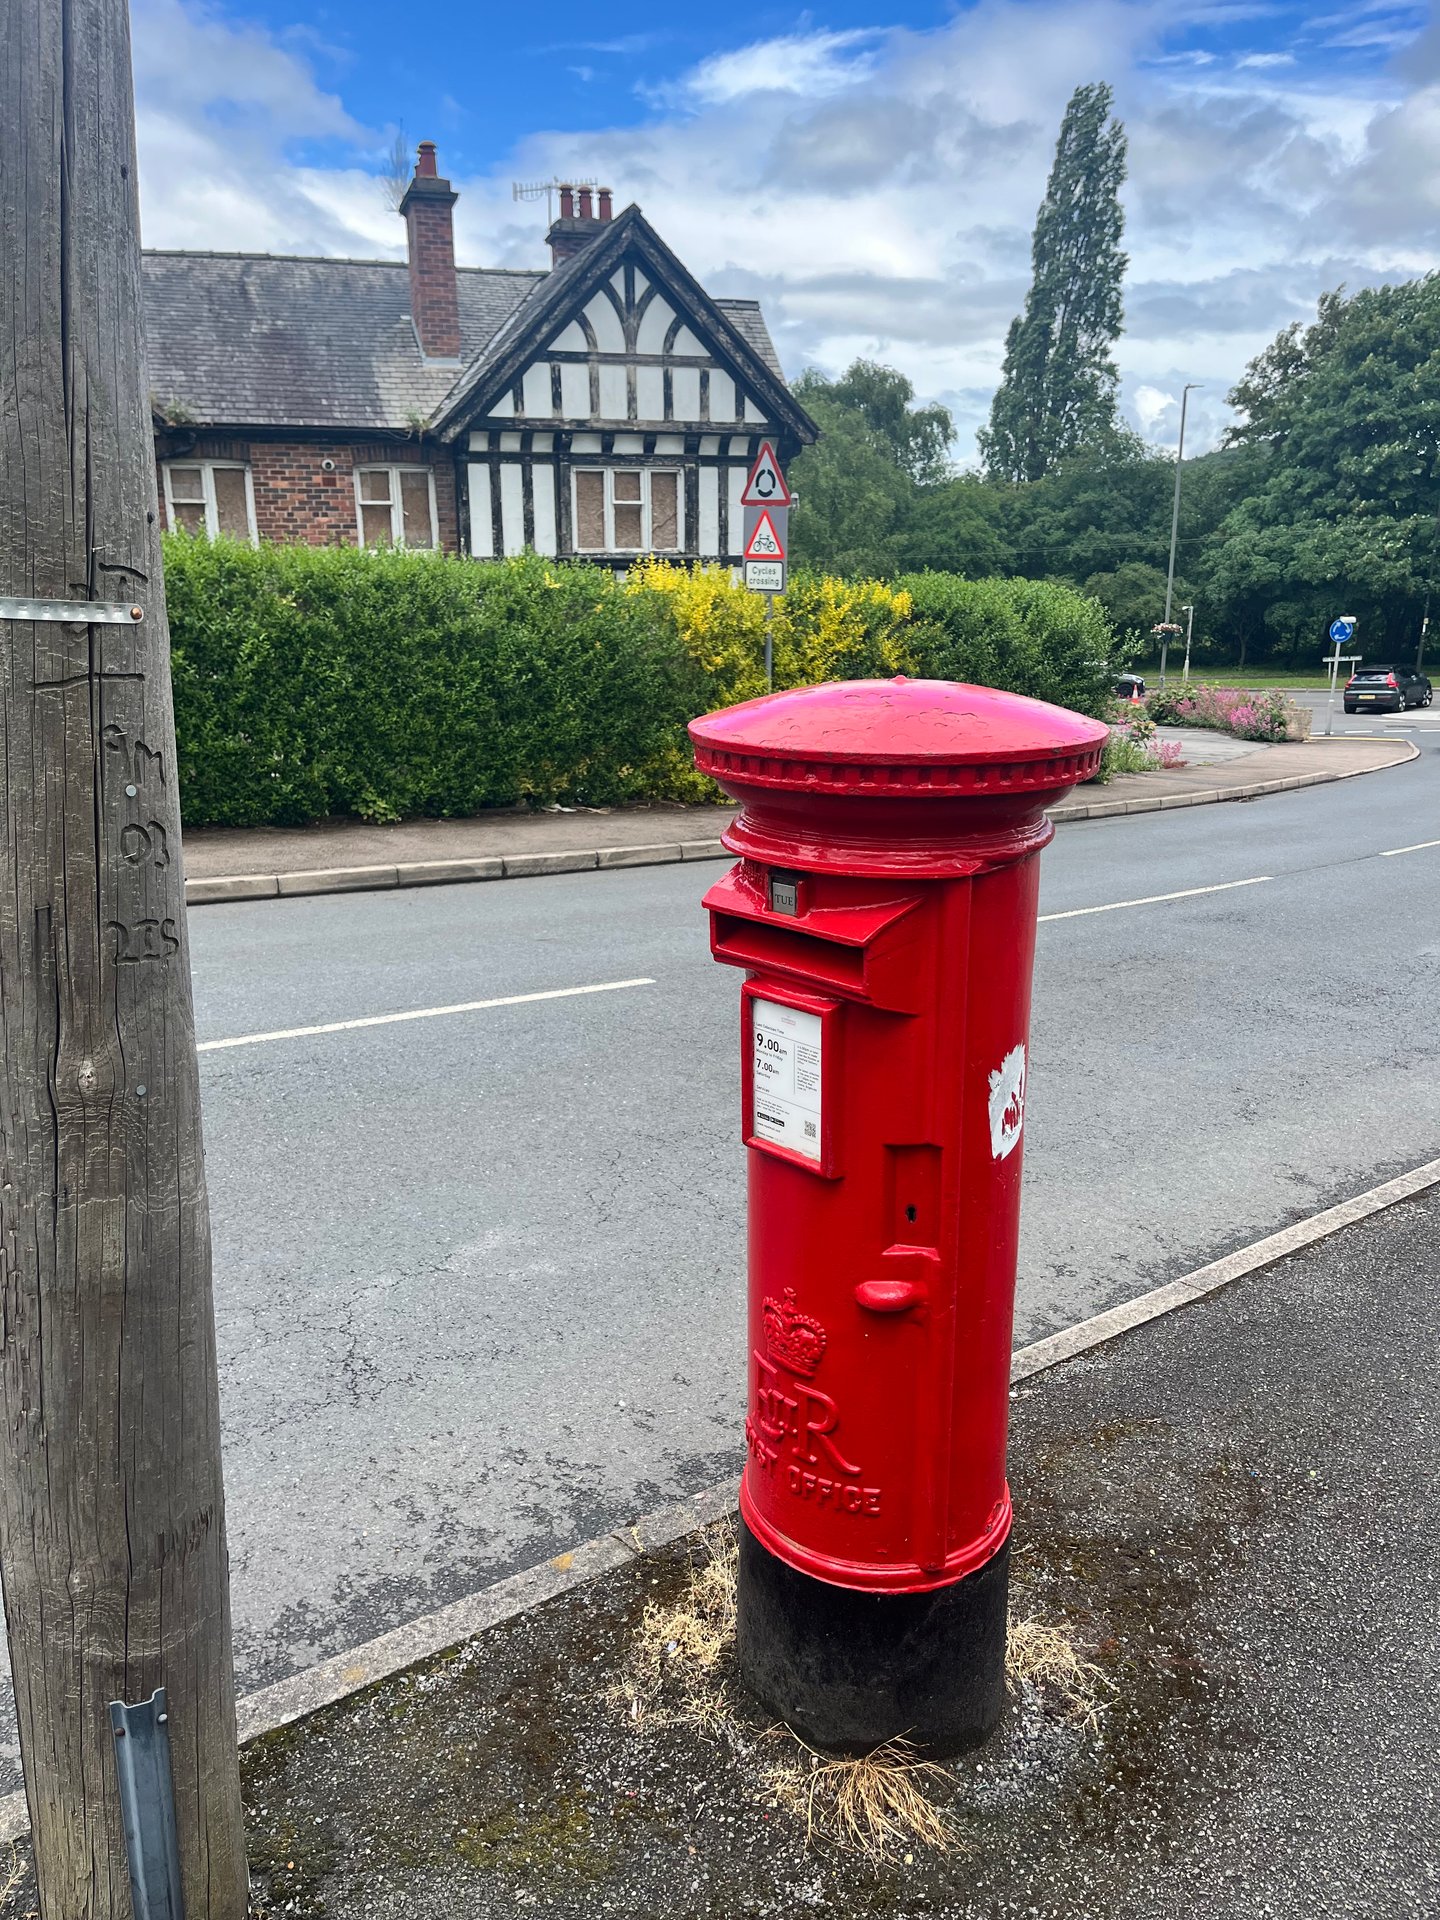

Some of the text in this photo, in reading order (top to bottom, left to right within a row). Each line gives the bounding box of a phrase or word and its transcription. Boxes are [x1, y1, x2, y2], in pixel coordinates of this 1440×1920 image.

[752, 566, 776, 576] Cycles
[749, 577, 780, 587] crossing
[774, 893, 794, 907] TUE
[786, 1464, 882, 1517] OFFICE
